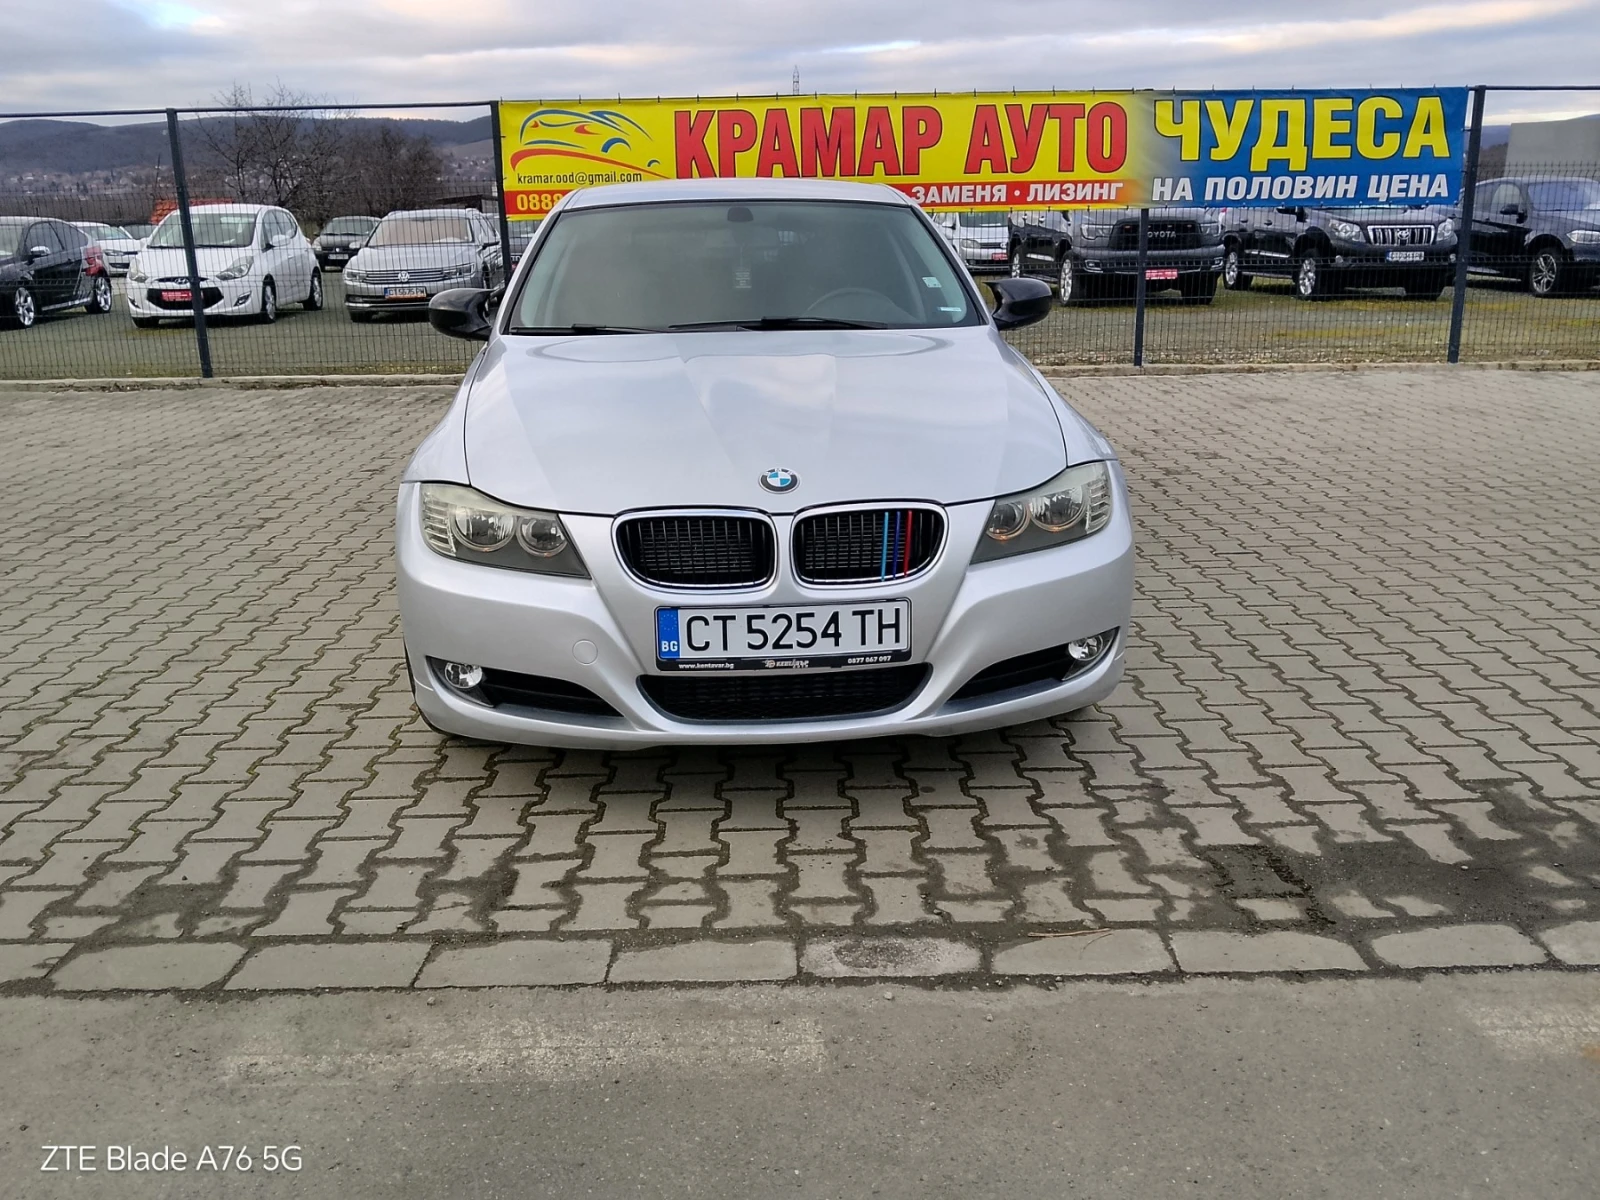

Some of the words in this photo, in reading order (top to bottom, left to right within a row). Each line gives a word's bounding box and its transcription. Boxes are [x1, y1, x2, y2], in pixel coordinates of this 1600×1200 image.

[674, 105, 943, 178] КРАМАР
[964, 101, 1128, 174] АУТО
[1154, 96, 1451, 173] ЧУДЕСА
[517, 171, 642, 185] kramar.ood@gmail.com
[1152, 176, 1194, 202] НА
[1204, 175, 1356, 202] ПОЛОВИН
[1365, 173, 1449, 202] ЦЕНА
[911, 184, 1006, 204] ЗАМЕНЯ
[1028, 182, 1123, 202] ЛИЗИНГ
[686, 615, 737, 651] CT
[746, 610, 842, 651] 5254
[852, 608, 901, 646] TH
[661, 640, 678, 652] BG
